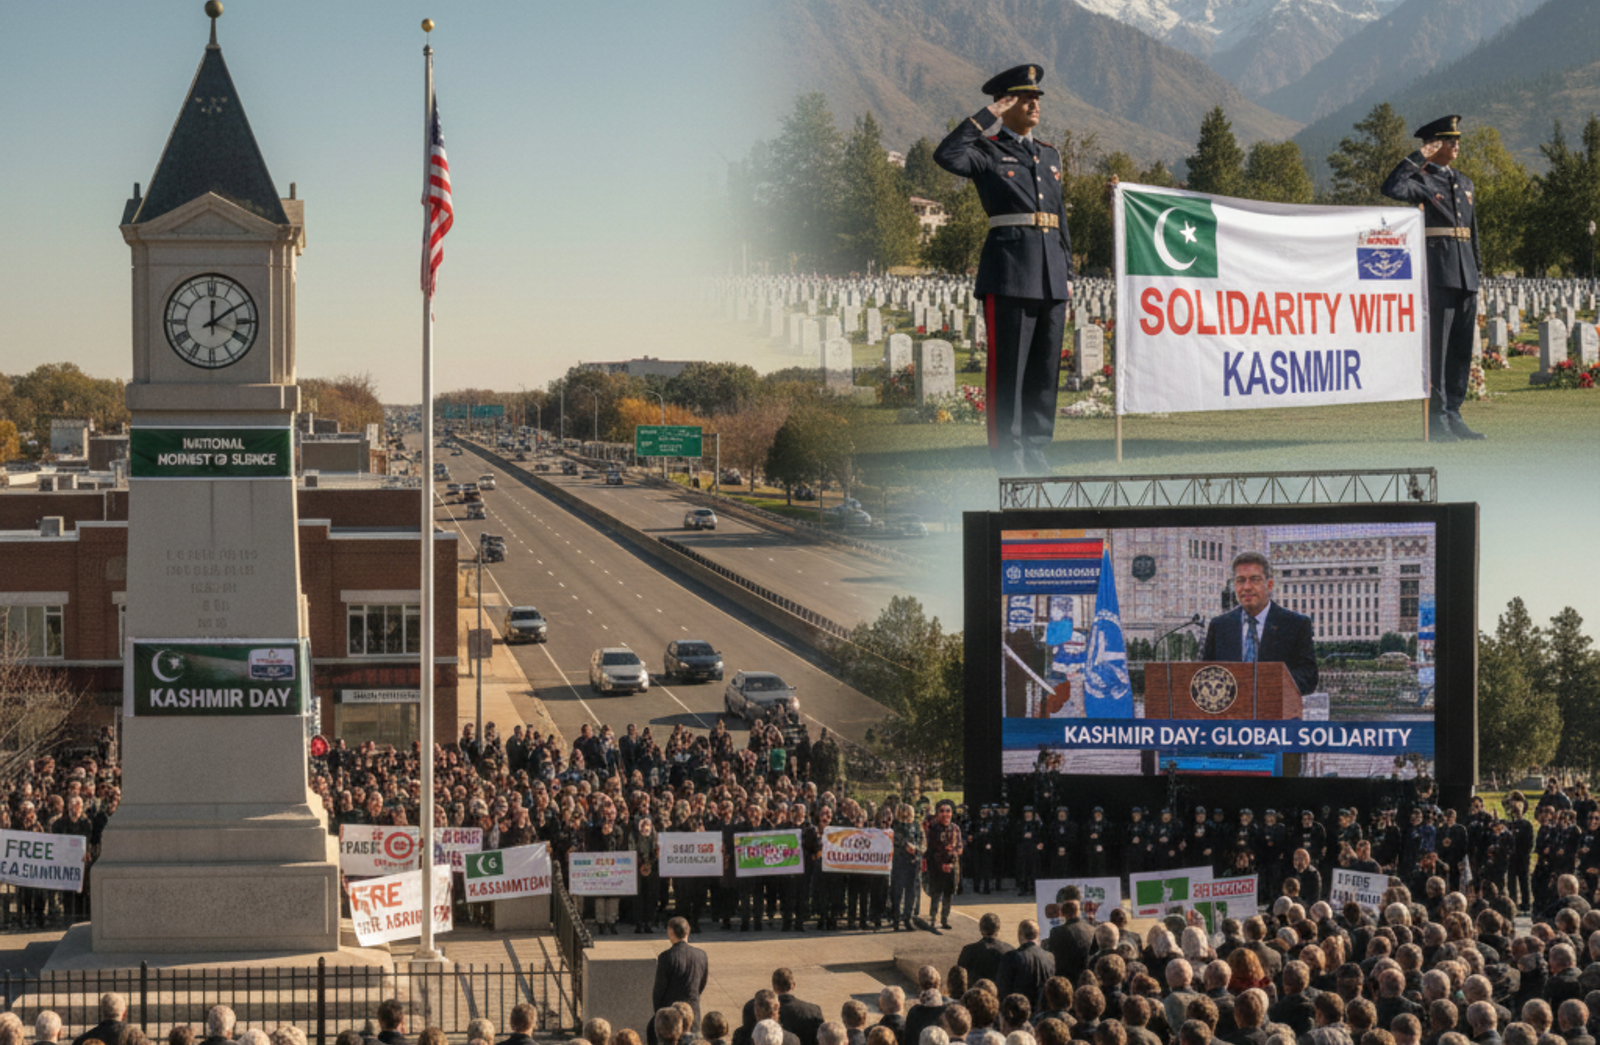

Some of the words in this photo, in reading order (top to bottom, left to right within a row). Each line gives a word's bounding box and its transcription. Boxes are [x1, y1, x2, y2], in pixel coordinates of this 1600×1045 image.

[1139, 287, 1342, 335] SOLIDARITY
[1350, 293, 1415, 333] WITH
[150, 688, 243, 708] KASHMIR
[249, 687, 291, 708] DAY
[1064, 725, 1155, 745] KASHMIR
[1160, 726, 1207, 746] DAY:
[1211, 727, 1292, 746] GLOBAL
[5, 838, 54, 861] FREE
